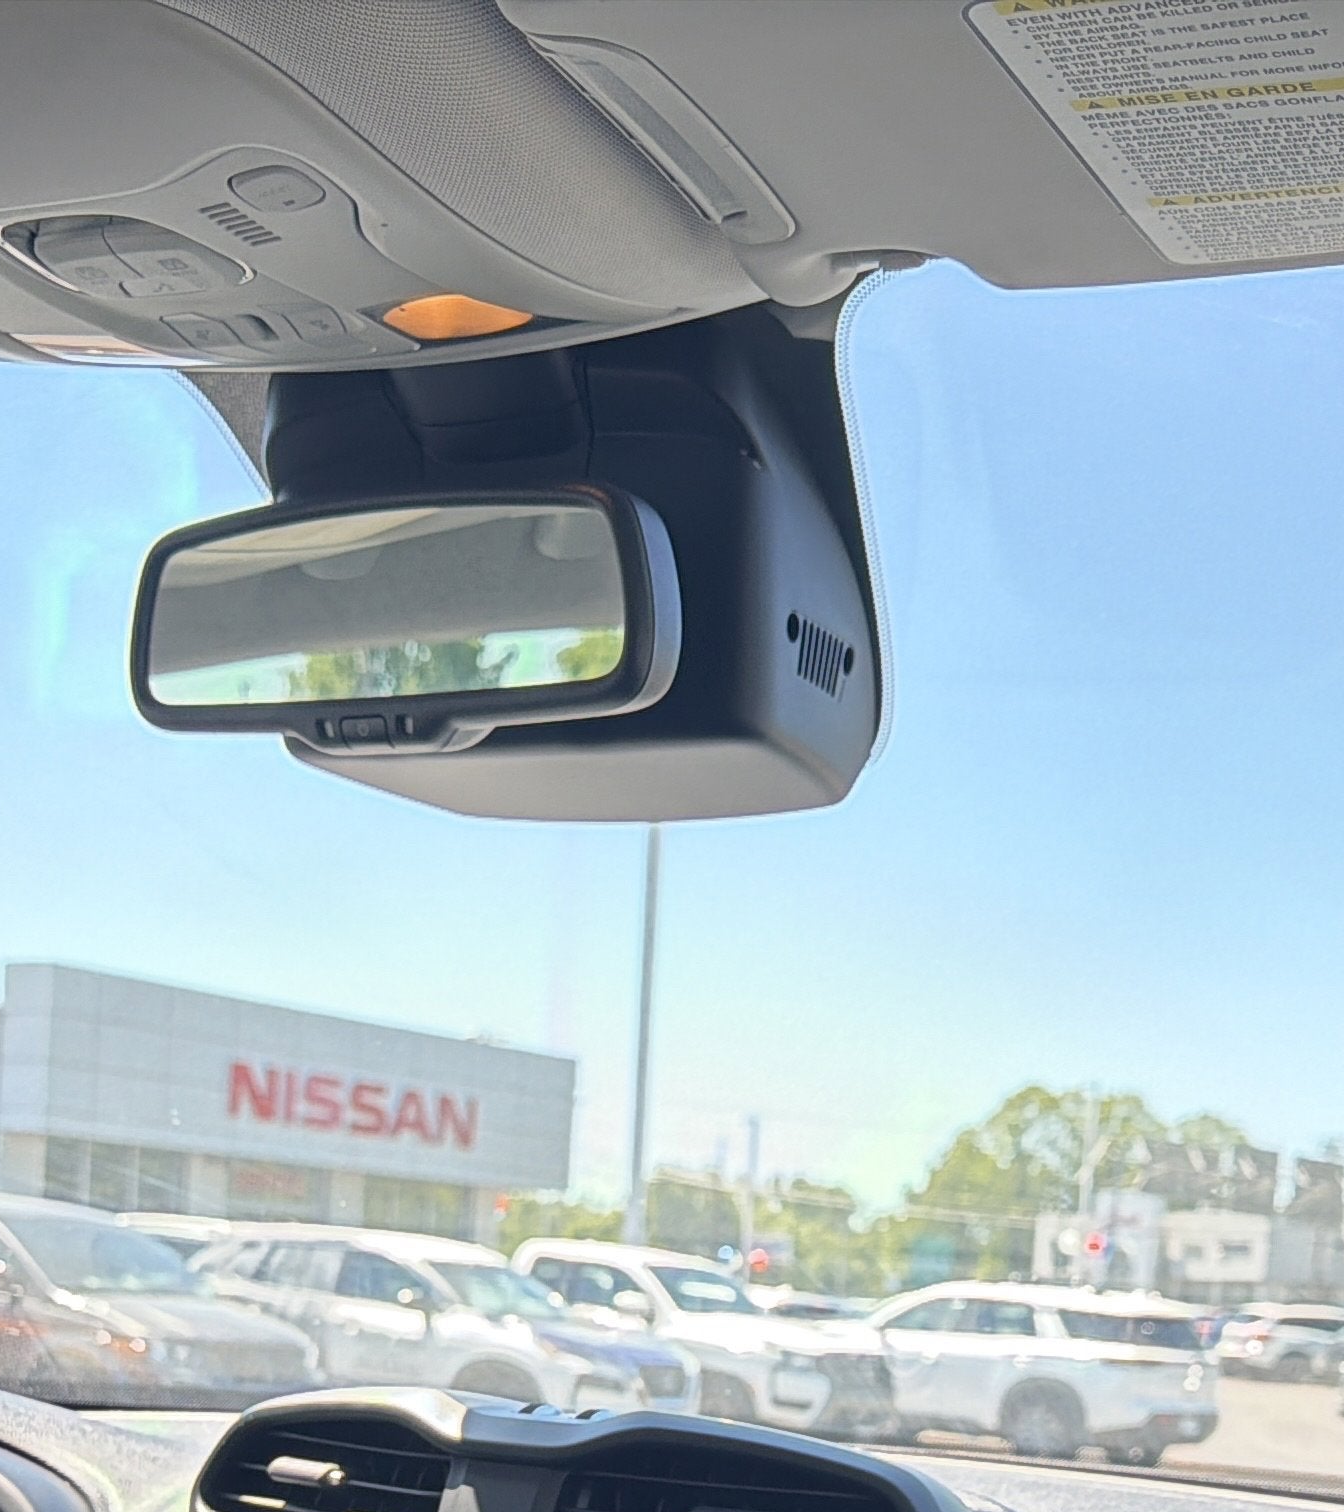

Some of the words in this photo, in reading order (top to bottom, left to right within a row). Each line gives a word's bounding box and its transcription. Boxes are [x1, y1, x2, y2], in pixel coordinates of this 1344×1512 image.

[1006, 14, 1053, 27] EVEN
[1058, 8, 1103, 21] WITH
[1026, 19, 1099, 33] CHILDREN
[1102, 15, 1133, 25] CAN
[1138, 12, 1157, 21] BE
[1161, 5, 1213, 17] KILLED
[1216, 2, 1239, 11] OR
[1032, 33, 1050, 42] BY
[1055, 29, 1082, 39] THE
[1037, 40, 1066, 49] THE
[1069, 36, 1104, 47] BACK
[1111, 31, 1149, 42] SEAT
[1152, 28, 1165, 37] IS
[1169, 24, 1197, 34] THE
[1200, 18, 1256, 32] SAFEST
[1259, 12, 1311, 25] PLACE
[1043, 47, 1072, 57] FOR
[1049, 53, 1096, 65] NEVER
[1099, 49, 1126, 59] PUT
[1130, 46, 1141, 56] A
[1143, 37, 1241, 54] REAR-FACING
[1243, 32, 1288, 44] CHILD
[1290, 28, 1329, 39] SEAT
[1055, 63, 1068, 71] IN
[1071, 59, 1099, 69] THE
[1061, 65, 1119, 78] ALWAYS
[1120, 62, 1148, 72] USE
[1152, 55, 1235, 69] SEATBELTS
[1238, 51, 1268, 61] AND
[1272, 47, 1316, 58] CHILD
[1071, 83, 1100, 92] SEE
[1101, 76, 1164, 90] OWNER'S
[1167, 71, 1228, 83] MANUAL
[1230, 68, 1260, 79] FOR
[1263, 64, 1304, 76] MORE
[1077, 88, 1124, 99] ABOUT
[1117, 90, 1183, 108] MISE
[1185, 86, 1219, 102] EN
[1226, 82, 1316, 98] GARDE
[1135, 106, 1181, 118] AVEC
[1184, 103, 1219, 114] DES
[1222, 99, 1270, 111] SACS
[1194, 204, 1228, 214] CON
[1232, 199, 1298, 211] BOLSAS
[226, 1060, 480, 1154] NISSAN
